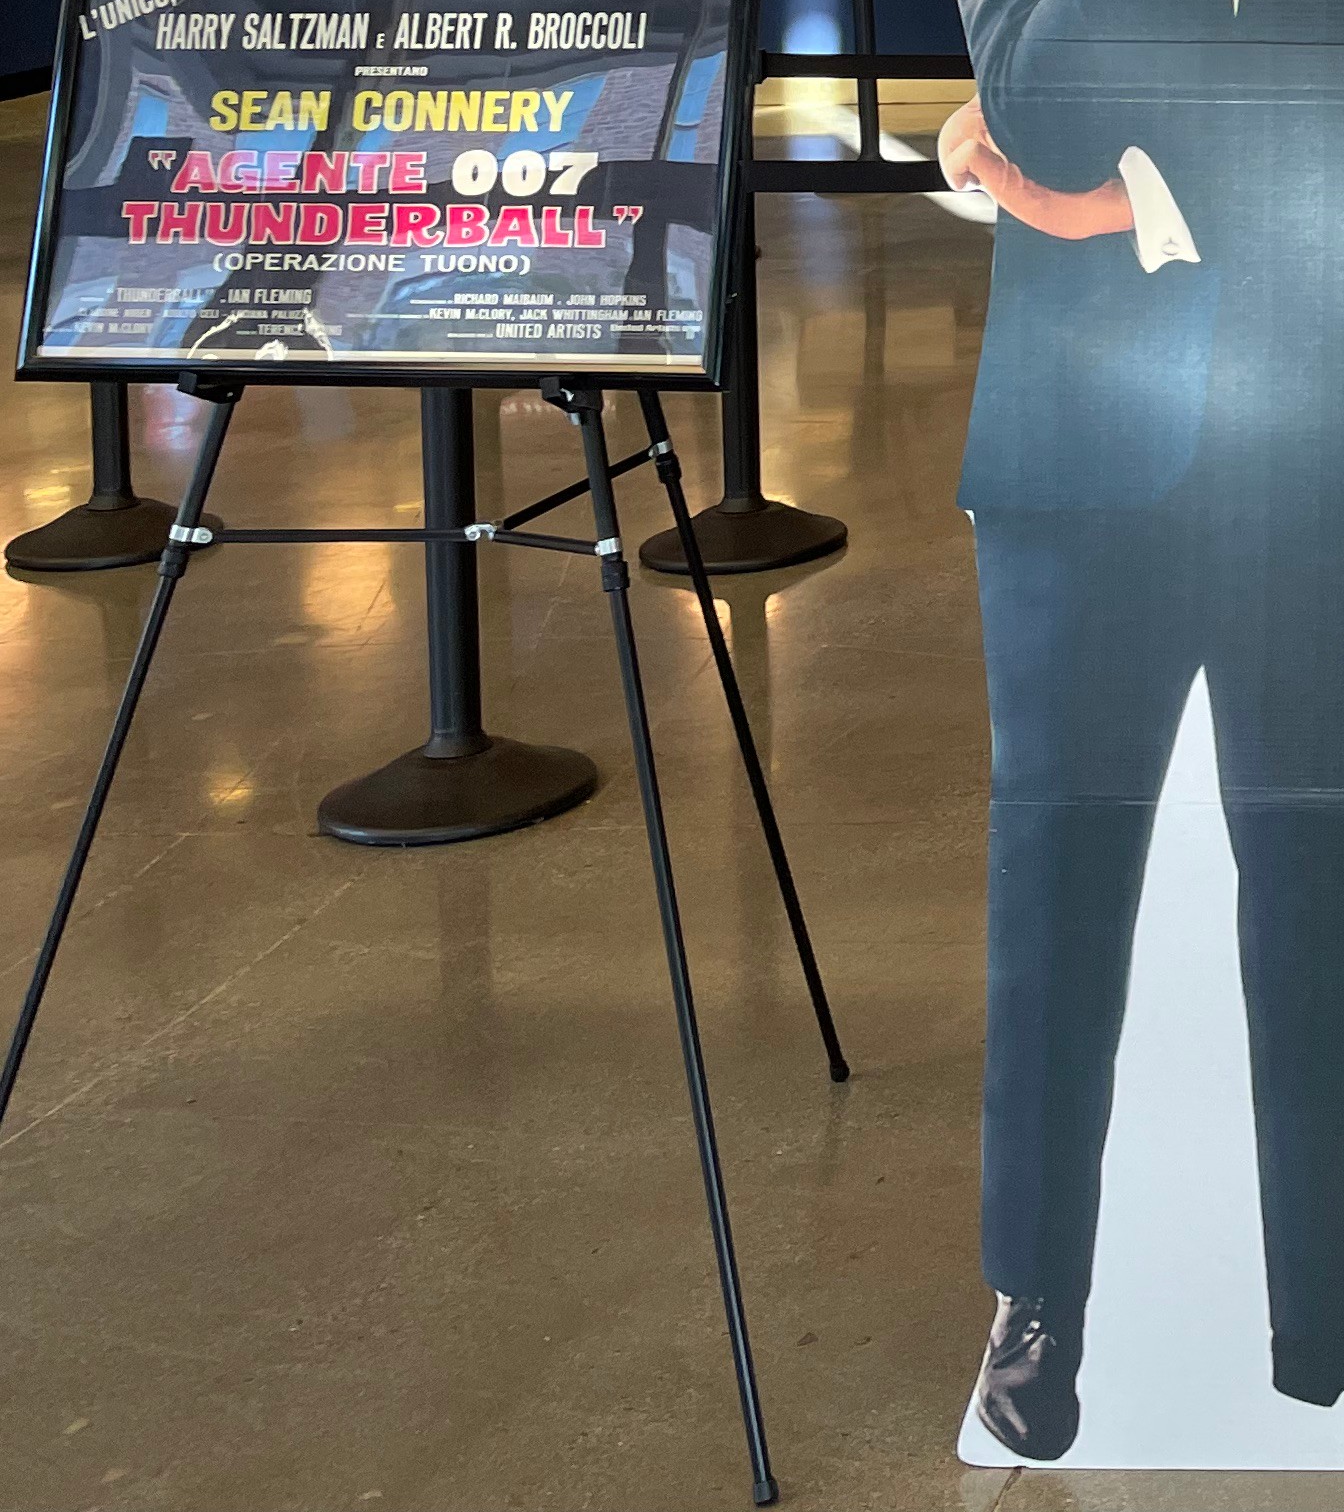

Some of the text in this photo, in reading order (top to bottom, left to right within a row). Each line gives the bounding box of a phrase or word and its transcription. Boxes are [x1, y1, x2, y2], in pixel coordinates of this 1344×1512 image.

[155, 11, 647, 51] HARRY SALTZMAN E ALBERT R. BROCCOLI
[354, 65, 428, 77] PRESENTANO
[210, 90, 574, 133] SEAN CONNERY
[451, 149, 600, 197] 007
[213, 252, 531, 276] (OPERAZIONE TUONO)
[566, 295, 596, 305] JOHN
[600, 294, 646, 306] HOPKINS
[495, 323, 542, 338] UNITED
[547, 324, 601, 339] ARTISTS
